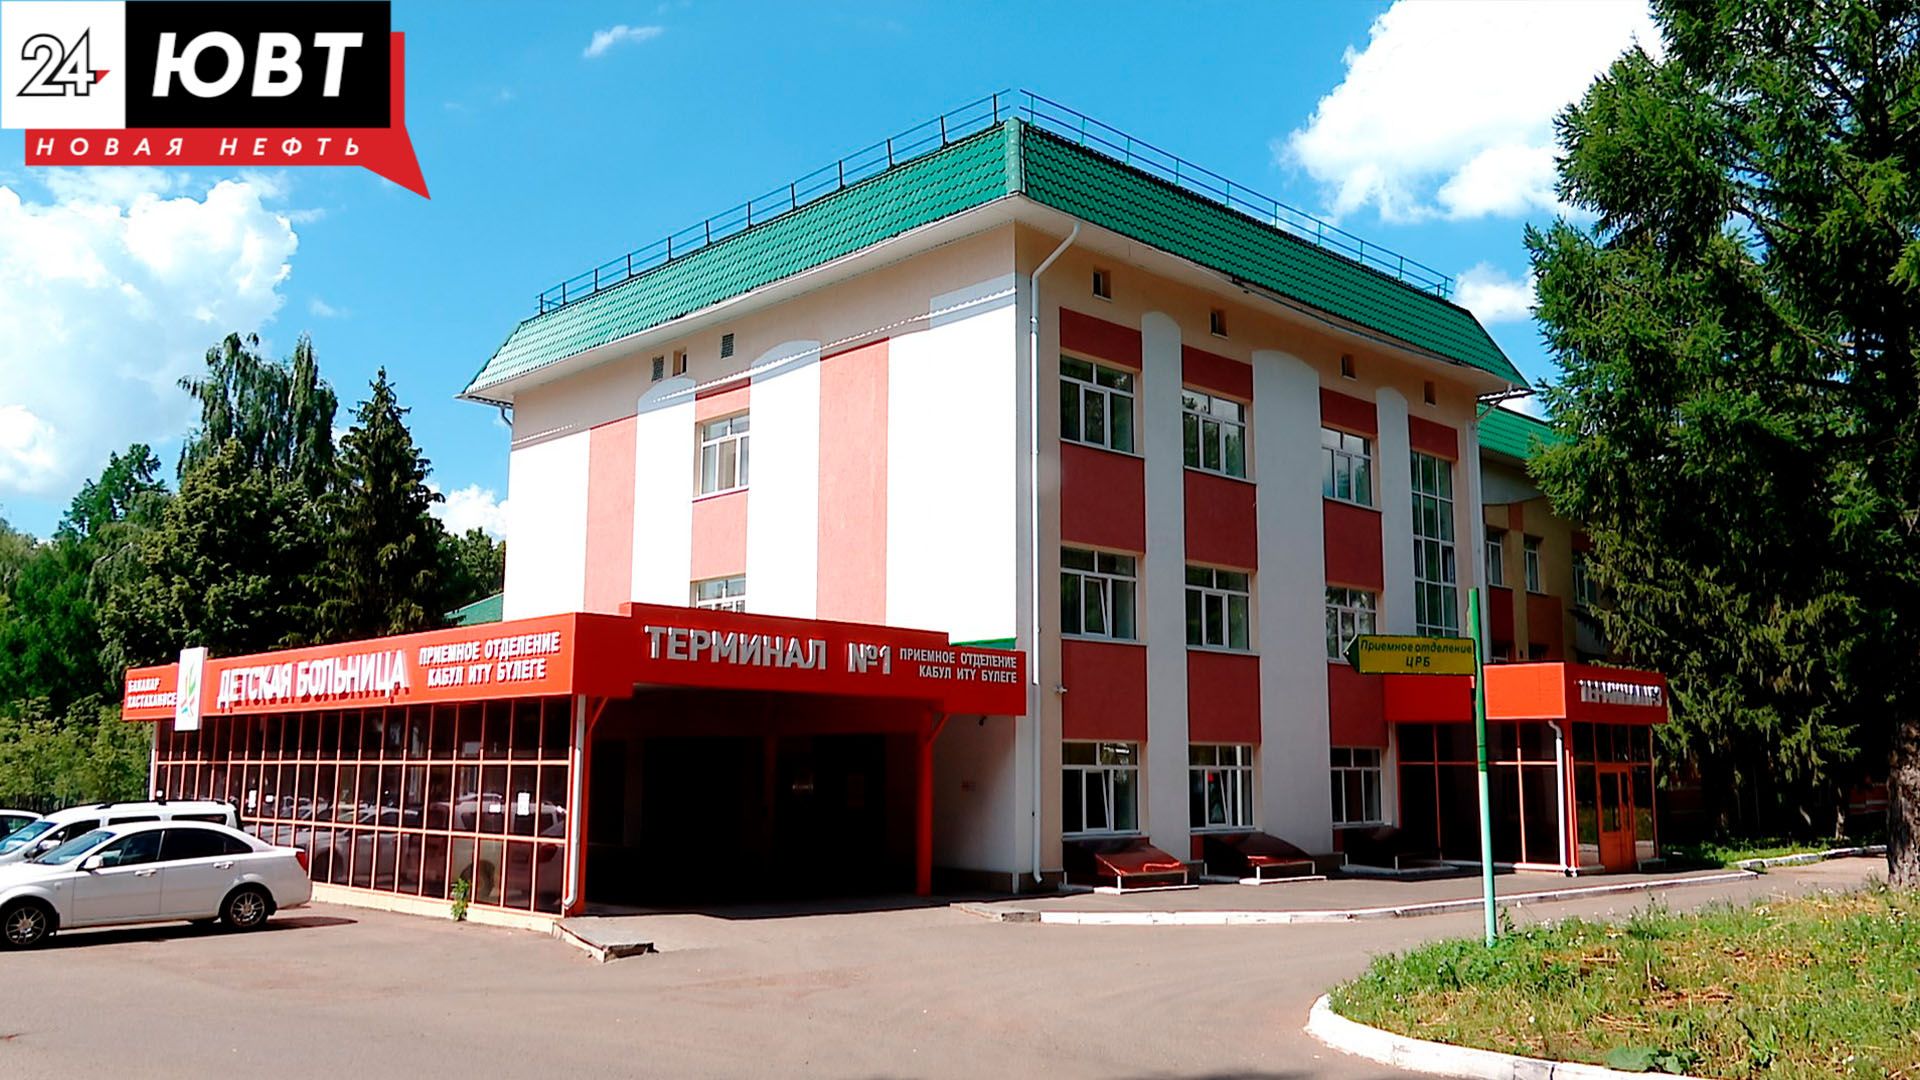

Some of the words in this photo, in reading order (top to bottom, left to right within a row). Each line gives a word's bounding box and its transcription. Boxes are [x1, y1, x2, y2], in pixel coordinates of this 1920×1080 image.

[418, 640, 481, 667] ПРИЕМНОЕ
[484, 631, 561, 661] ОТДЕЛЕНИЕ
[644, 624, 826, 671] ТЕРМИНАЛ
[847, 642, 892, 675] №1
[899, 647, 956, 664] ПРИЕМНОЕ
[960, 652, 1017, 669] ОТДЕЛЕНИЕ
[1360, 640, 1414, 653] Приемное
[1414, 641, 1473, 654] отделение
[919, 665, 952, 679] КАБУЛ
[1405, 656, 1431, 668] ЦРБ
[216, 662, 294, 710] ДЕТСКАЯ
[295, 649, 408, 699] БОЛЬНИЦА
[427, 665, 465, 688] КАБУЛ
